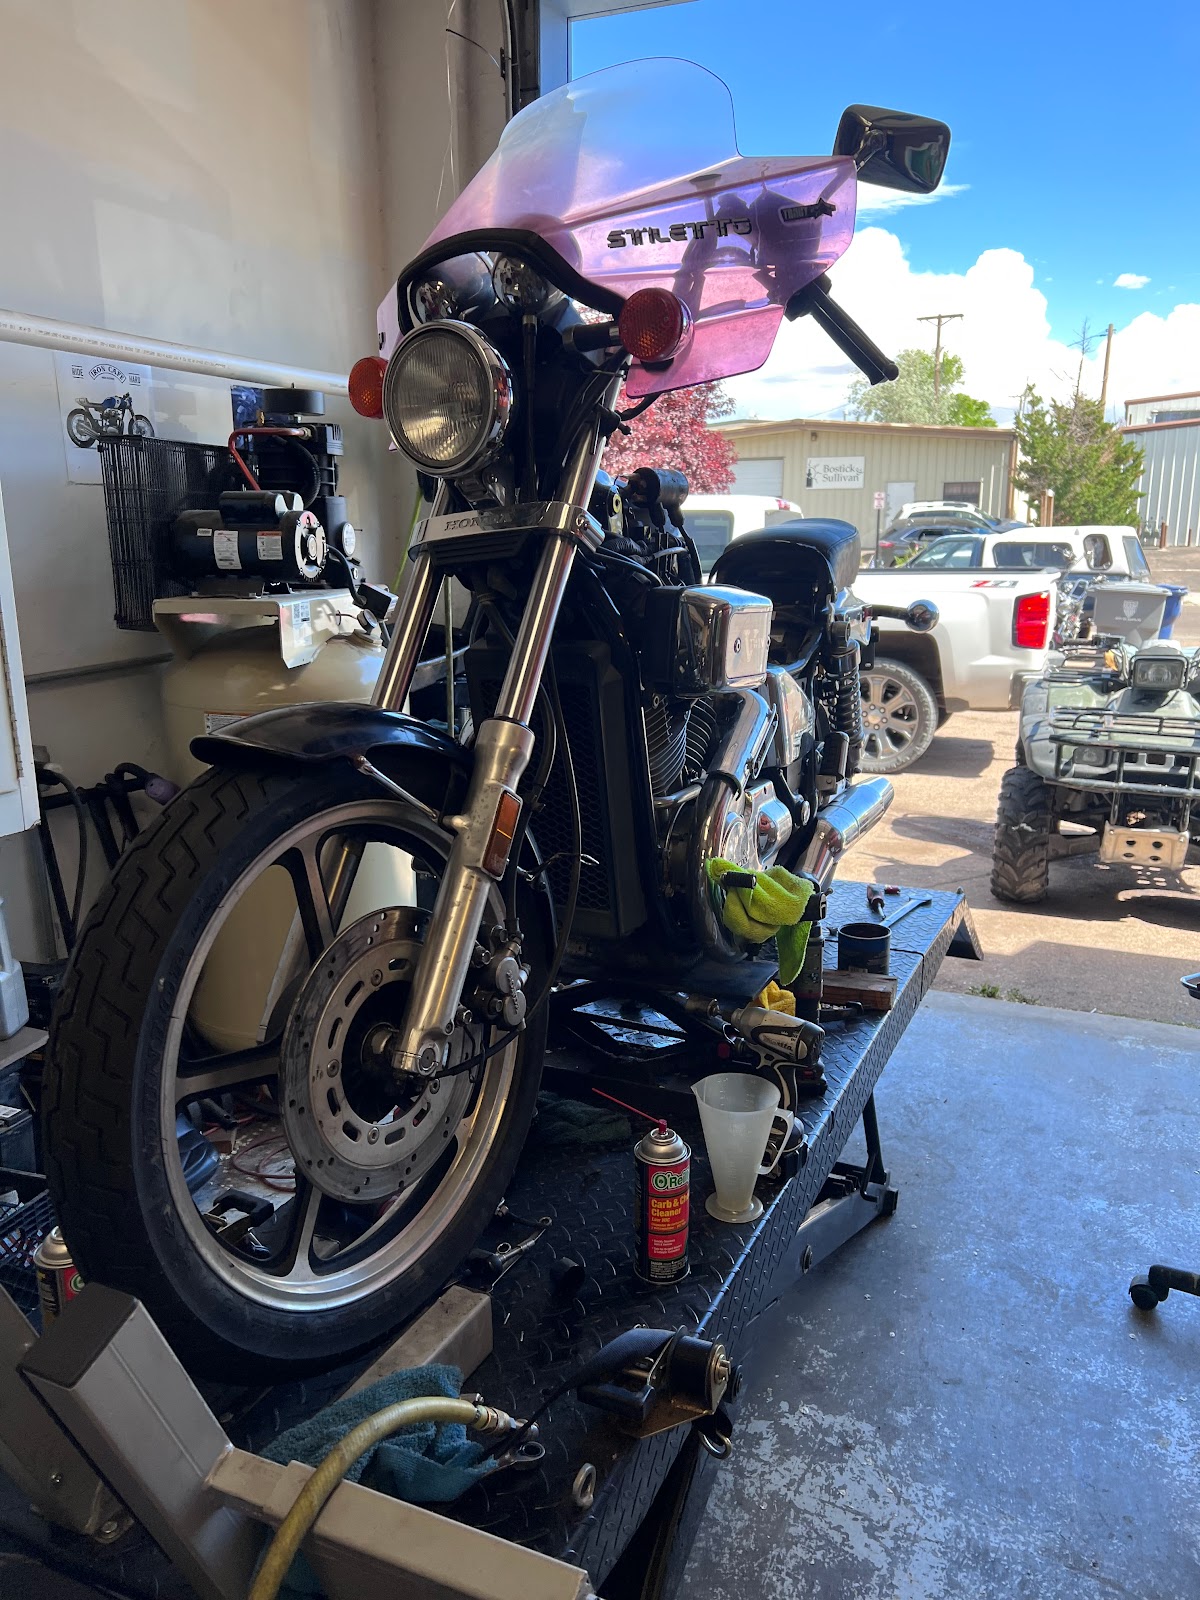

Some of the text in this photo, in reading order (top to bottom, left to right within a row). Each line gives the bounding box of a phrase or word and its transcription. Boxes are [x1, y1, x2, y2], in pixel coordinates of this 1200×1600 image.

[606, 218, 752, 248] STILETTO
[90, 365, 106, 377] IRON
[823, 464, 855, 473] Bostick
[822, 473, 859, 482] Sullivan
[444, 516, 480, 532] HON
[969, 579, 1019, 589] Z71
[651, 1199, 672, 1209] Carb
[673, 1198, 679, 1208] &
[651, 1208, 682, 1217] Cleaner
